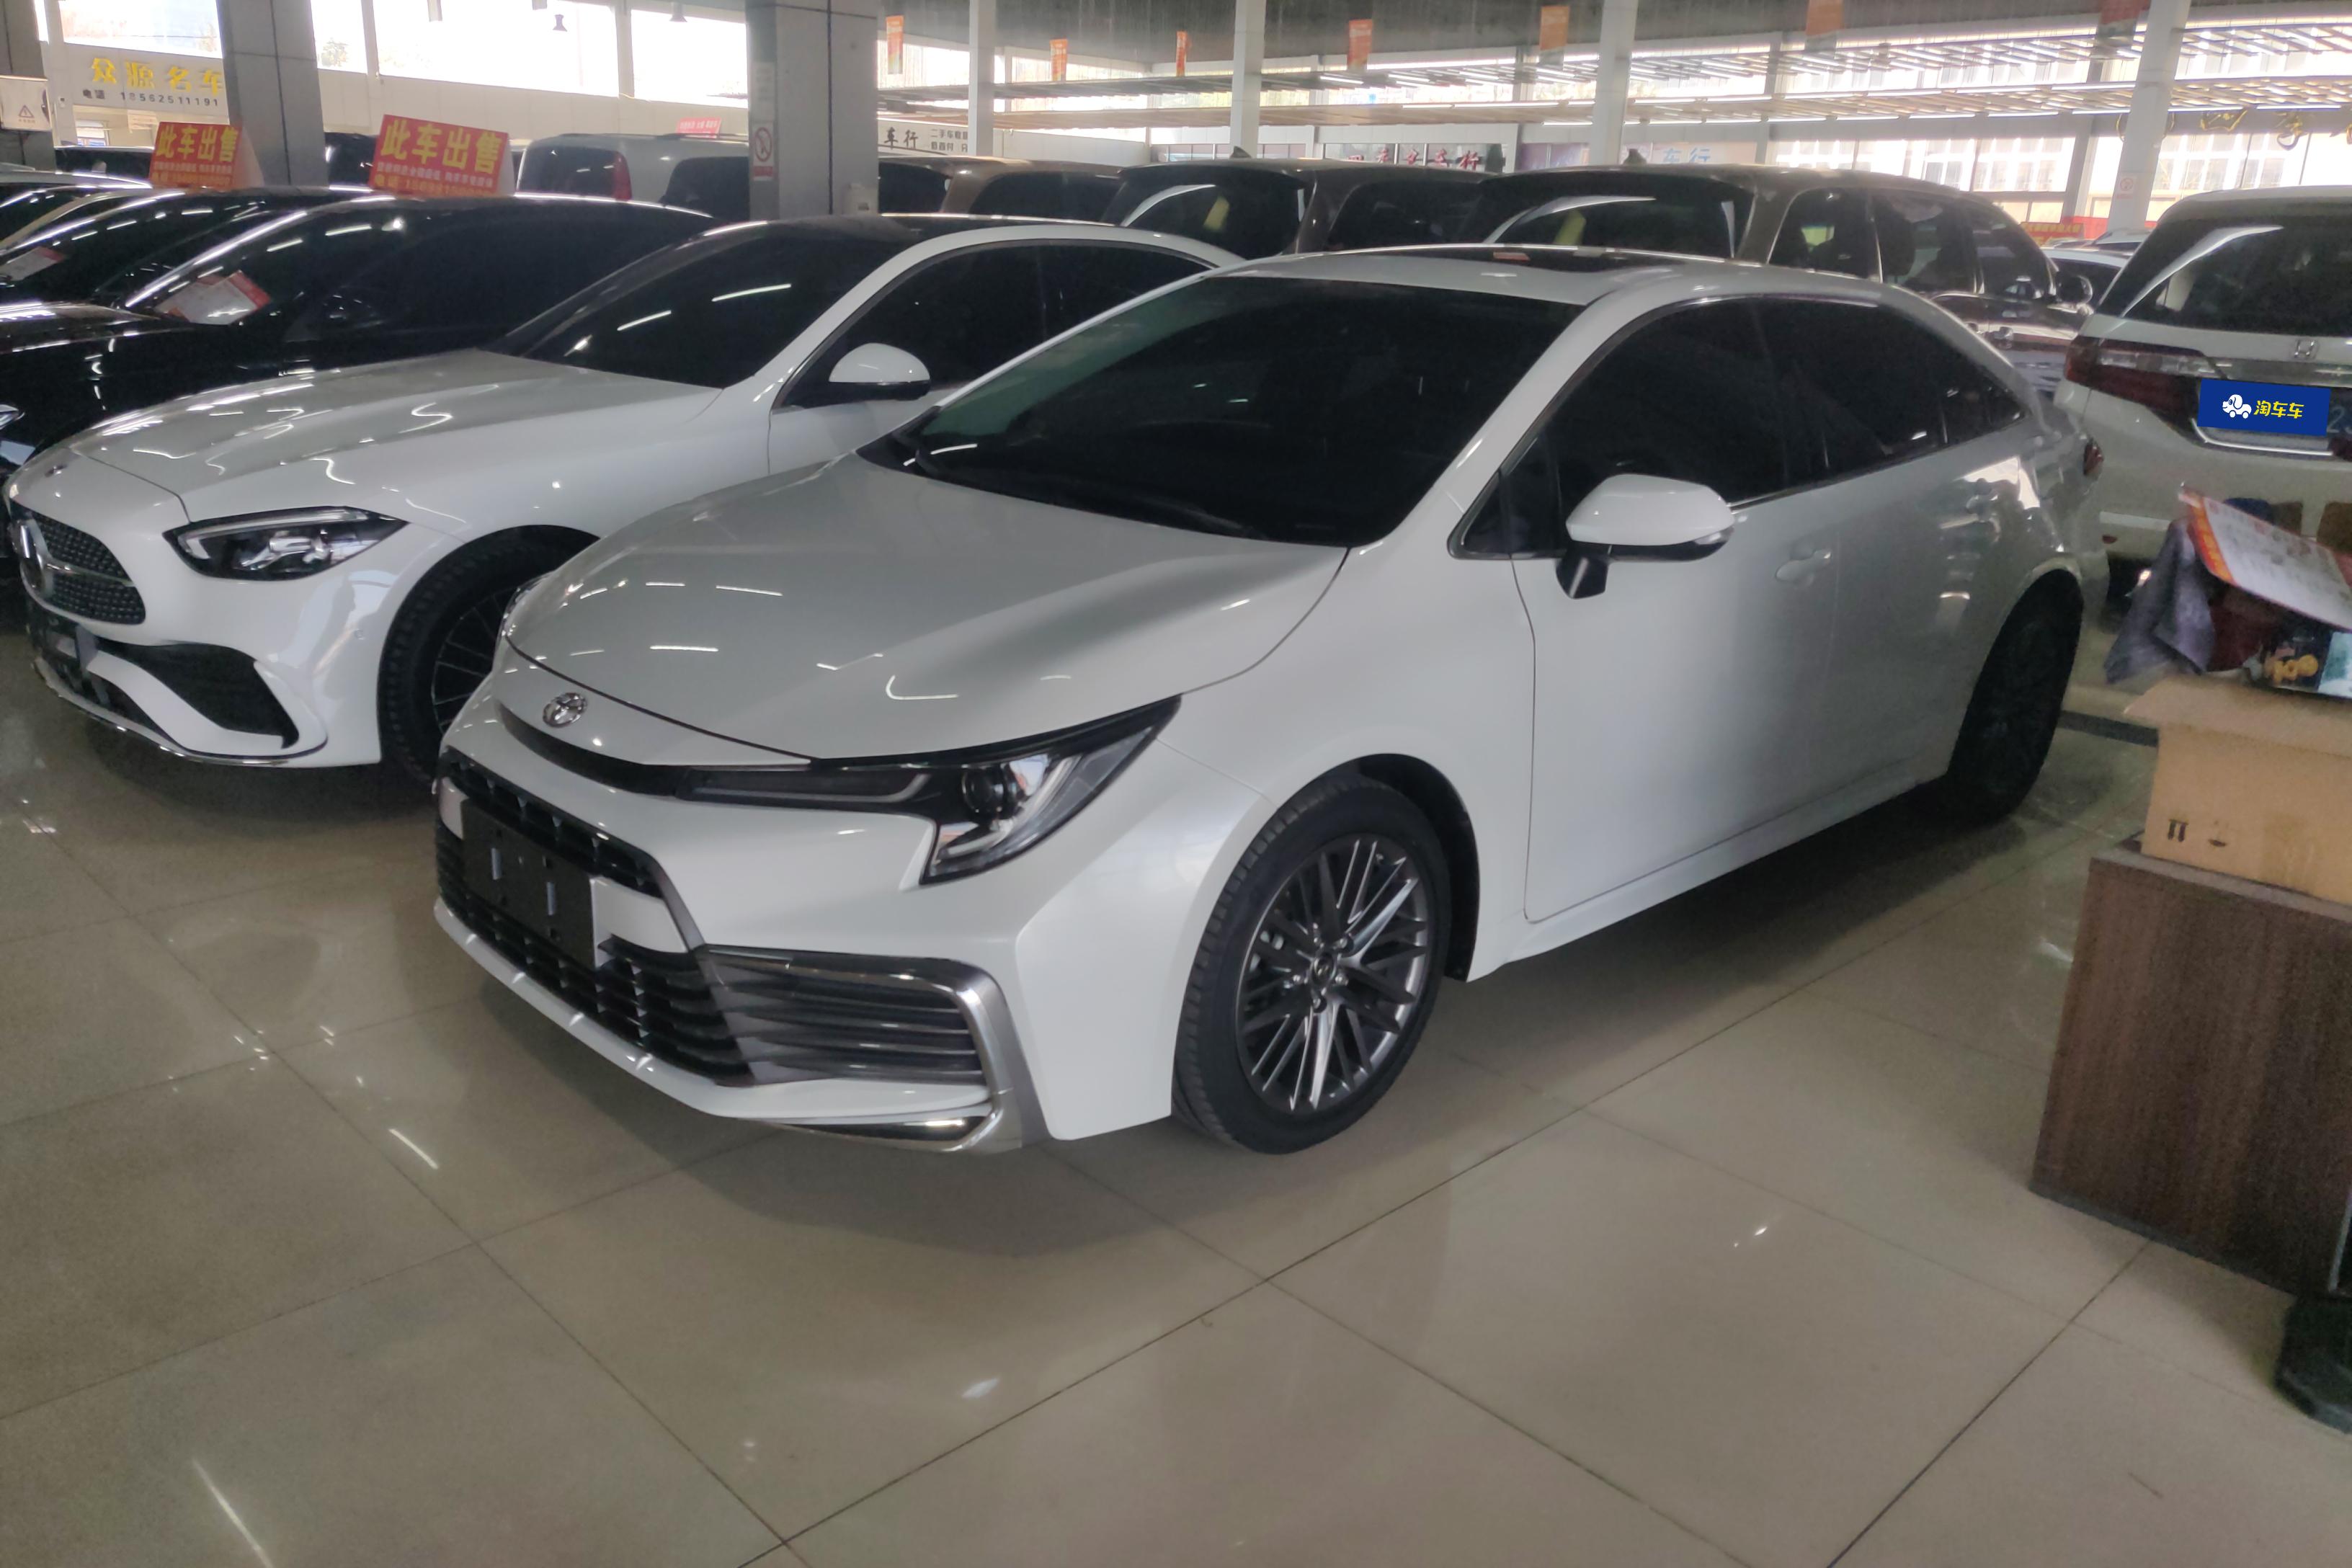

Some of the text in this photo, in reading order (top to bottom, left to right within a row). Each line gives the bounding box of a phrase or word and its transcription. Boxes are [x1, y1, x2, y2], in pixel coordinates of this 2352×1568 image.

[156, 124, 239, 162] 此车出售
[380, 118, 502, 174] 此车出售
